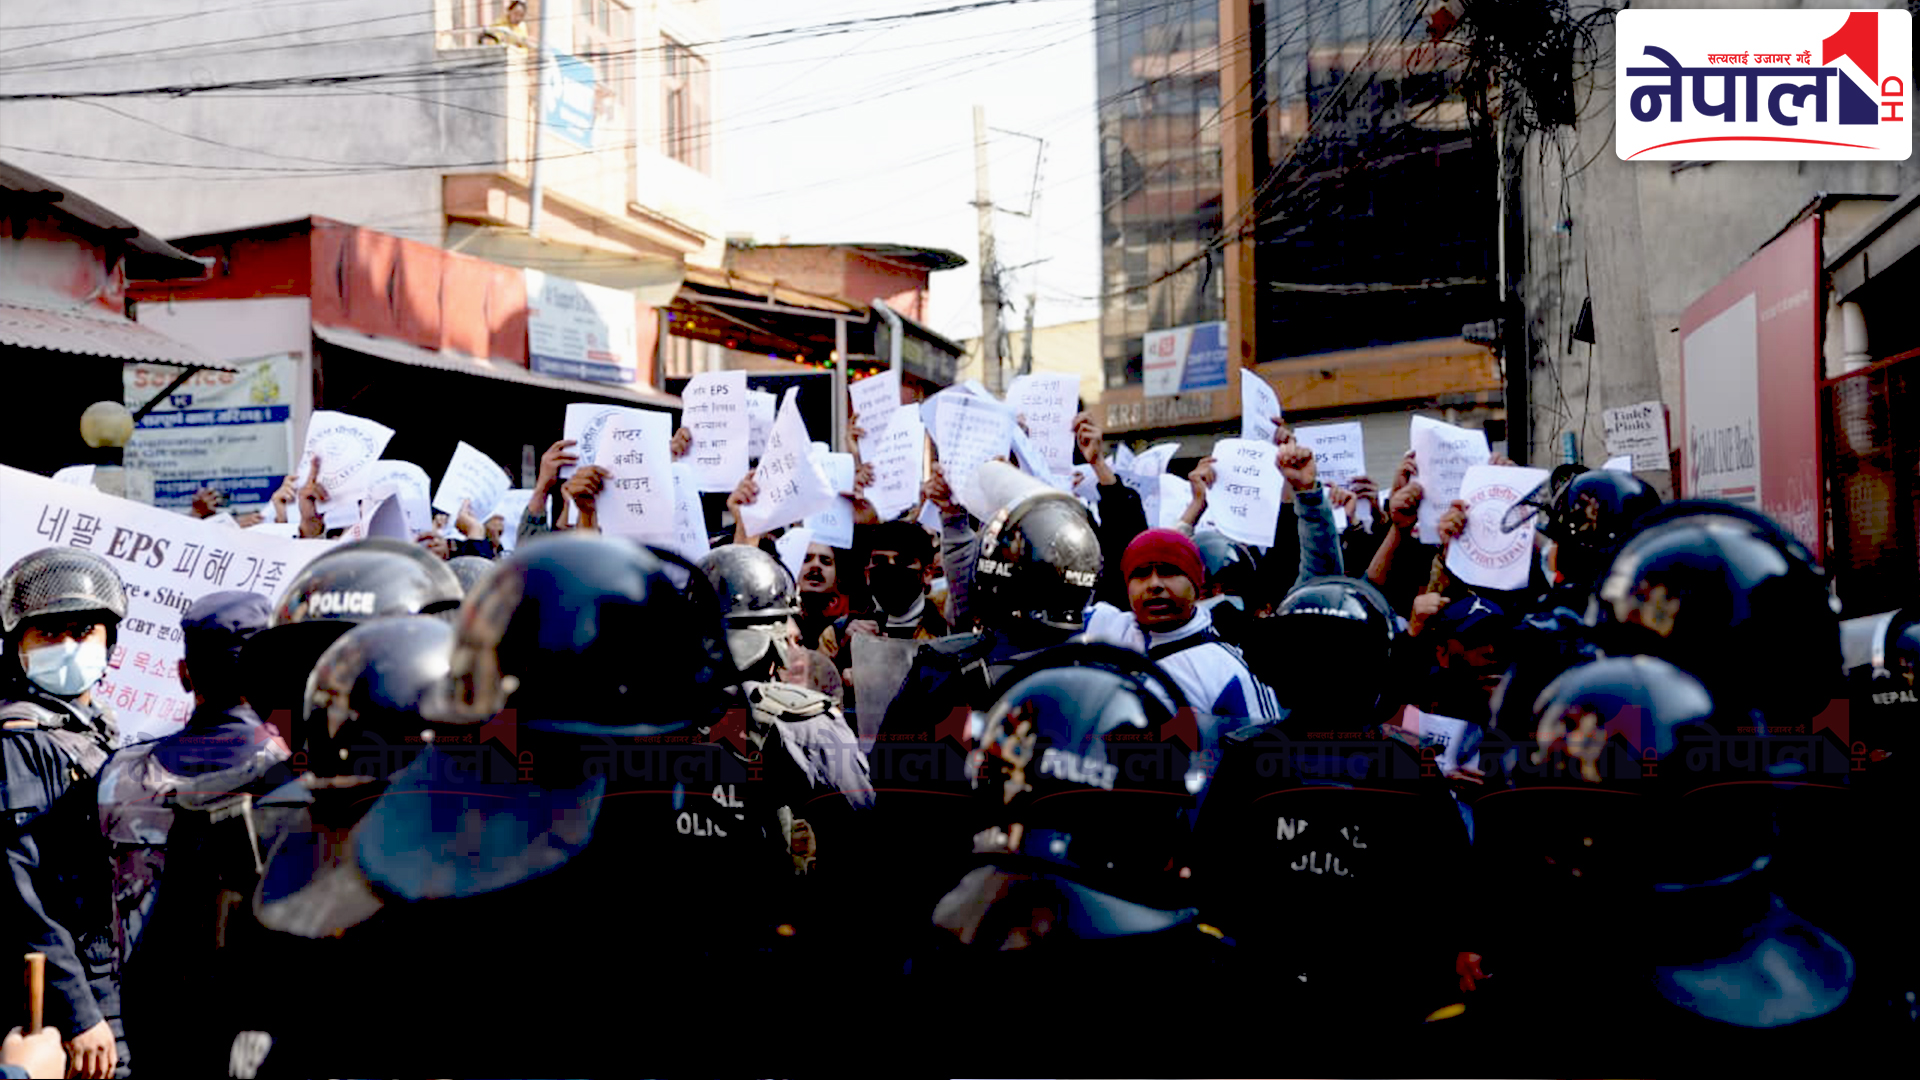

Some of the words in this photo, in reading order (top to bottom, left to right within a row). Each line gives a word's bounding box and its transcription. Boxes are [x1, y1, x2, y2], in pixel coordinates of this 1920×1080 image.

[37, 504, 101, 551] 네팔
[106, 527, 171, 568] EPS
[172, 542, 234, 586] 피해
[236, 556, 287, 597] 가족
[309, 590, 376, 616] POLICE
